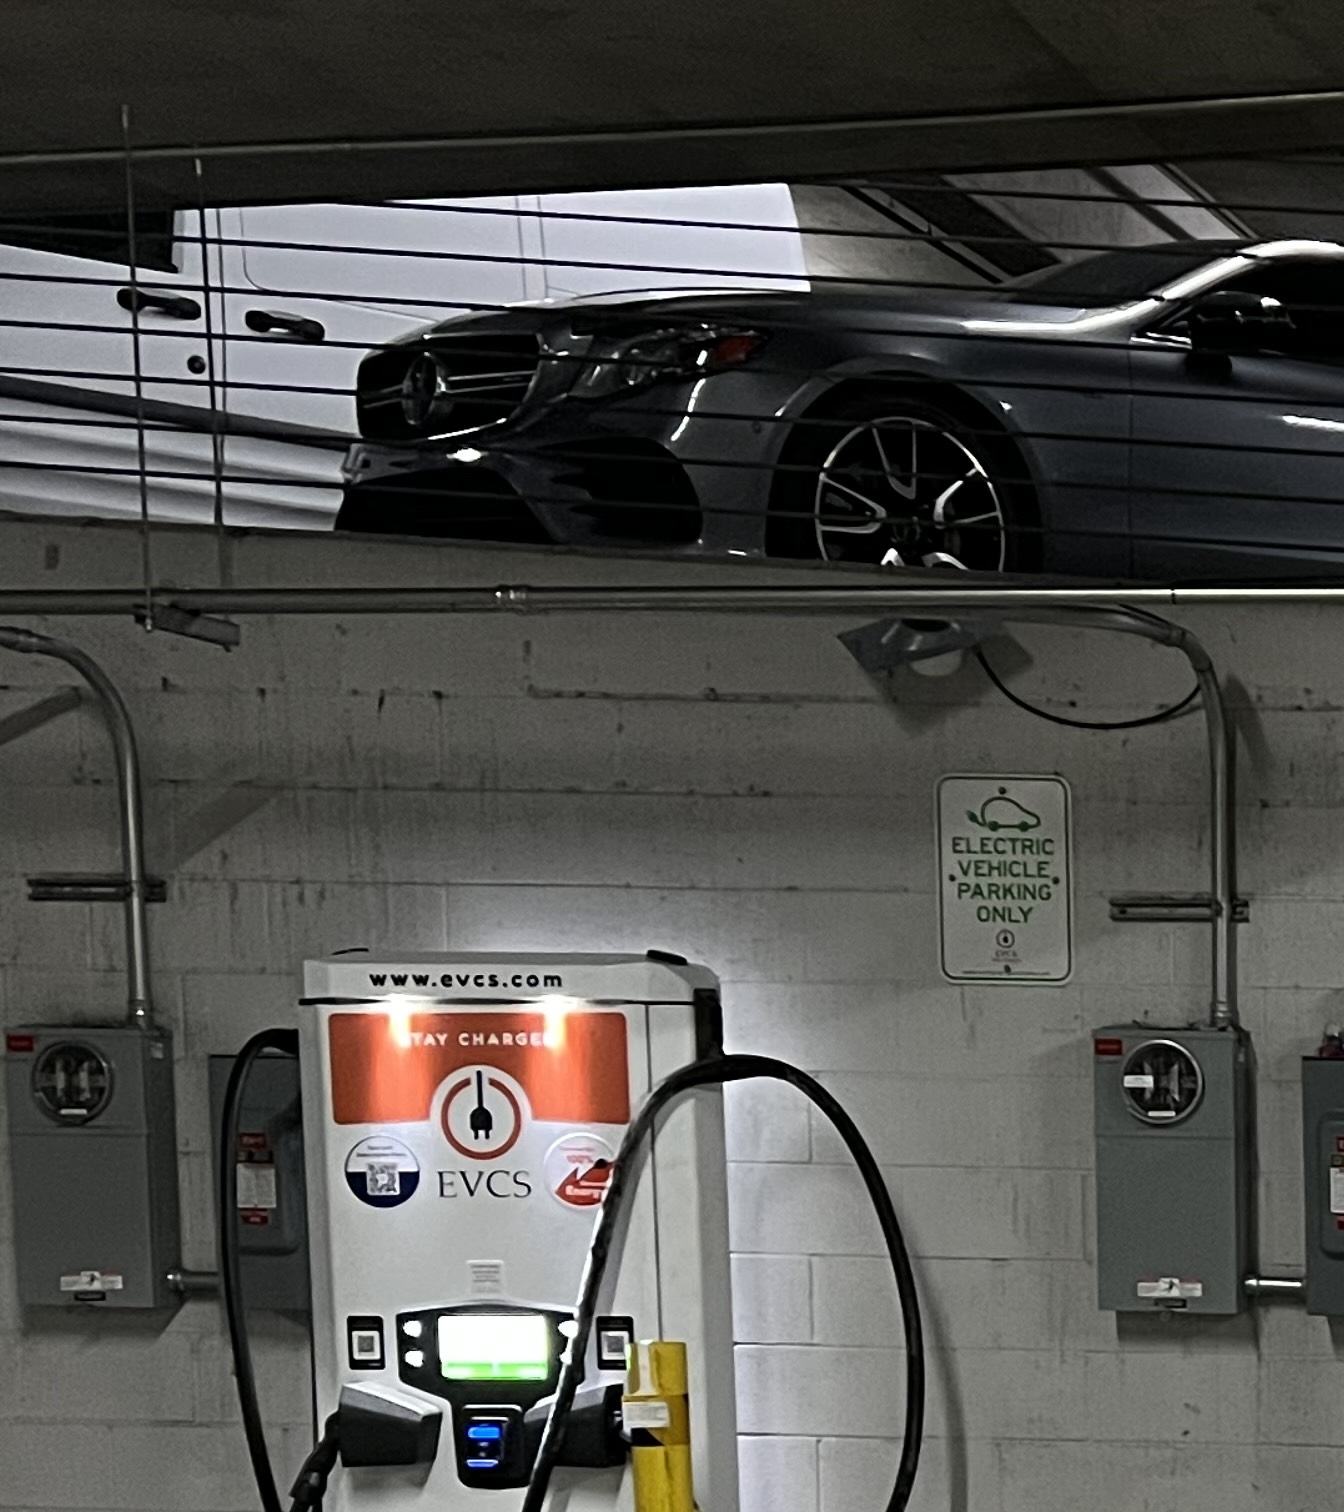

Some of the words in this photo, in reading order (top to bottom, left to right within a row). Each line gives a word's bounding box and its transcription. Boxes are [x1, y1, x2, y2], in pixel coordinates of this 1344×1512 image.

[951, 836, 1055, 855] ELECTRIC
[957, 859, 1050, 878] VEHICLE
[957, 882, 1052, 901] PARKING
[976, 905, 1034, 923] ONLY
[369, 971, 563, 988] www.evcs.com
[400, 1032, 448, 1047] TAY
[458, 1032, 556, 1047] CHARGE
[436, 1169, 533, 1200] EVCS
